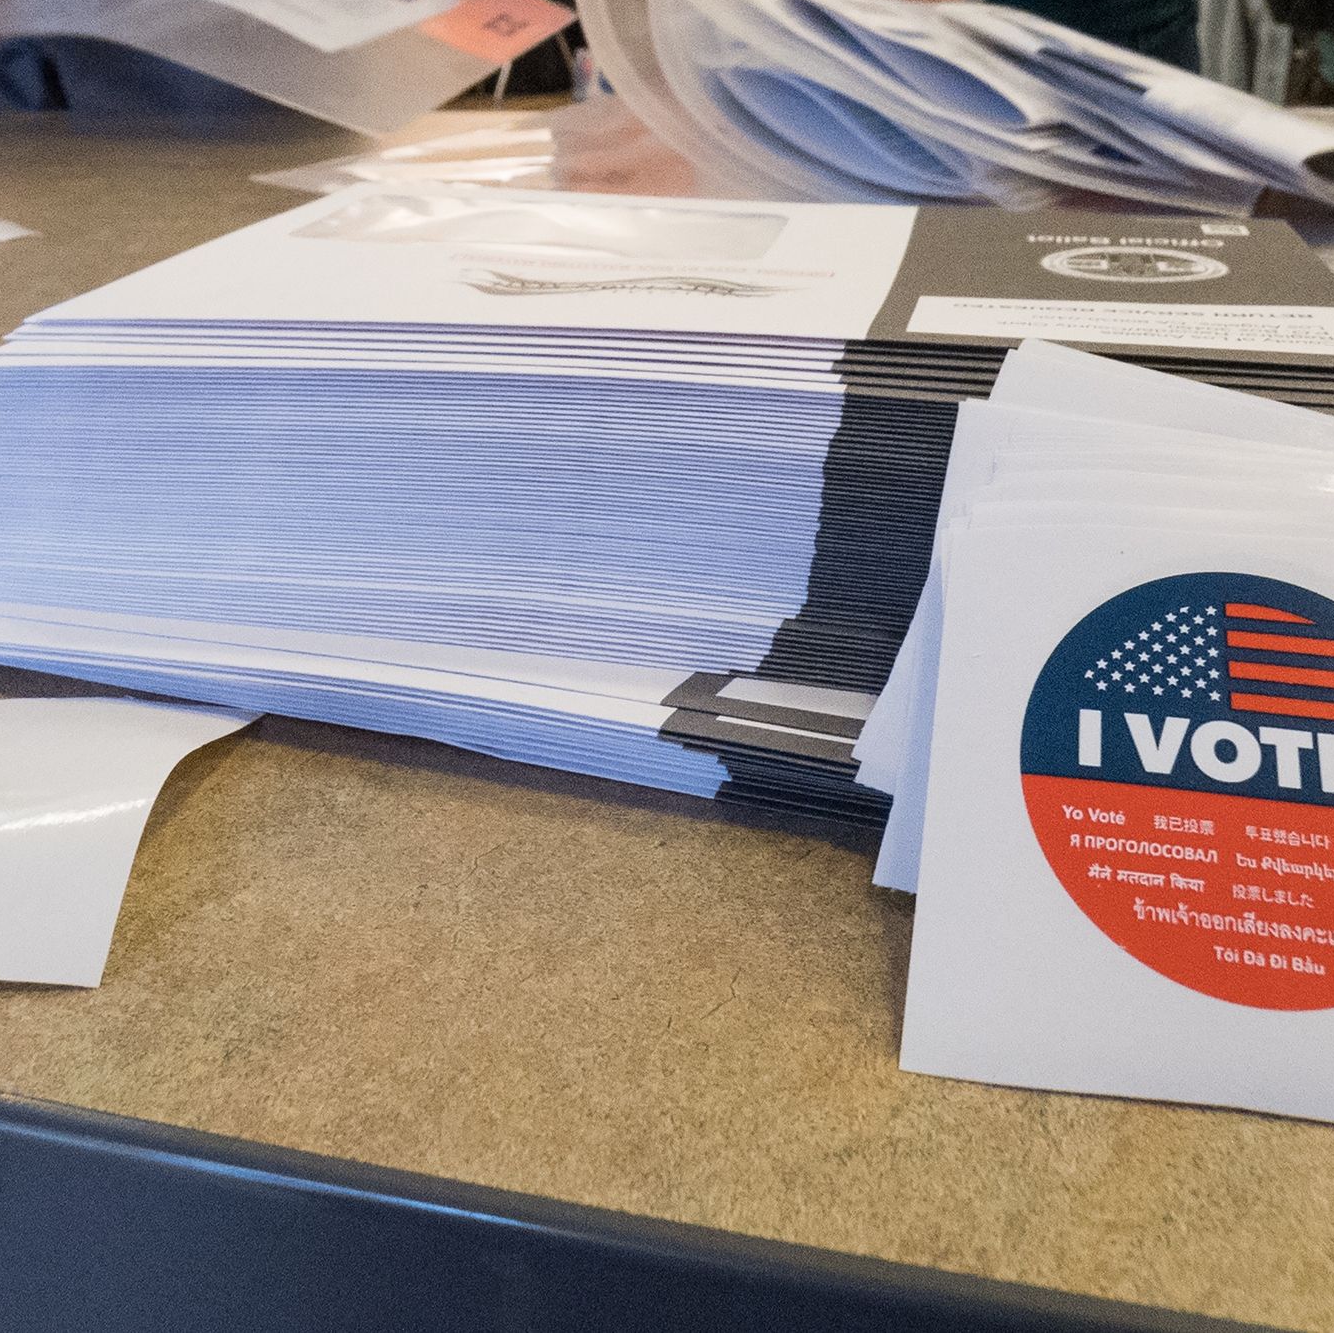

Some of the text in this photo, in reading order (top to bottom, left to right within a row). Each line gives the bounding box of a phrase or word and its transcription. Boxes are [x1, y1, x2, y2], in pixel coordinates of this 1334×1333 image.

[1027, 234, 1224, 247] Official Ballot
[953, 303, 1095, 313] REQUESTED
[1078, 709, 1102, 768] I
[1061, 804, 1126, 826] Yo Voté
[1153, 814, 1215, 836] 我已投票
[1069, 833, 1218, 864] Я ПРОГОЛОСОВАЛ
[1245, 824, 1331, 850] 투표했습니다
[1231, 883, 1315, 909] 投票しました
